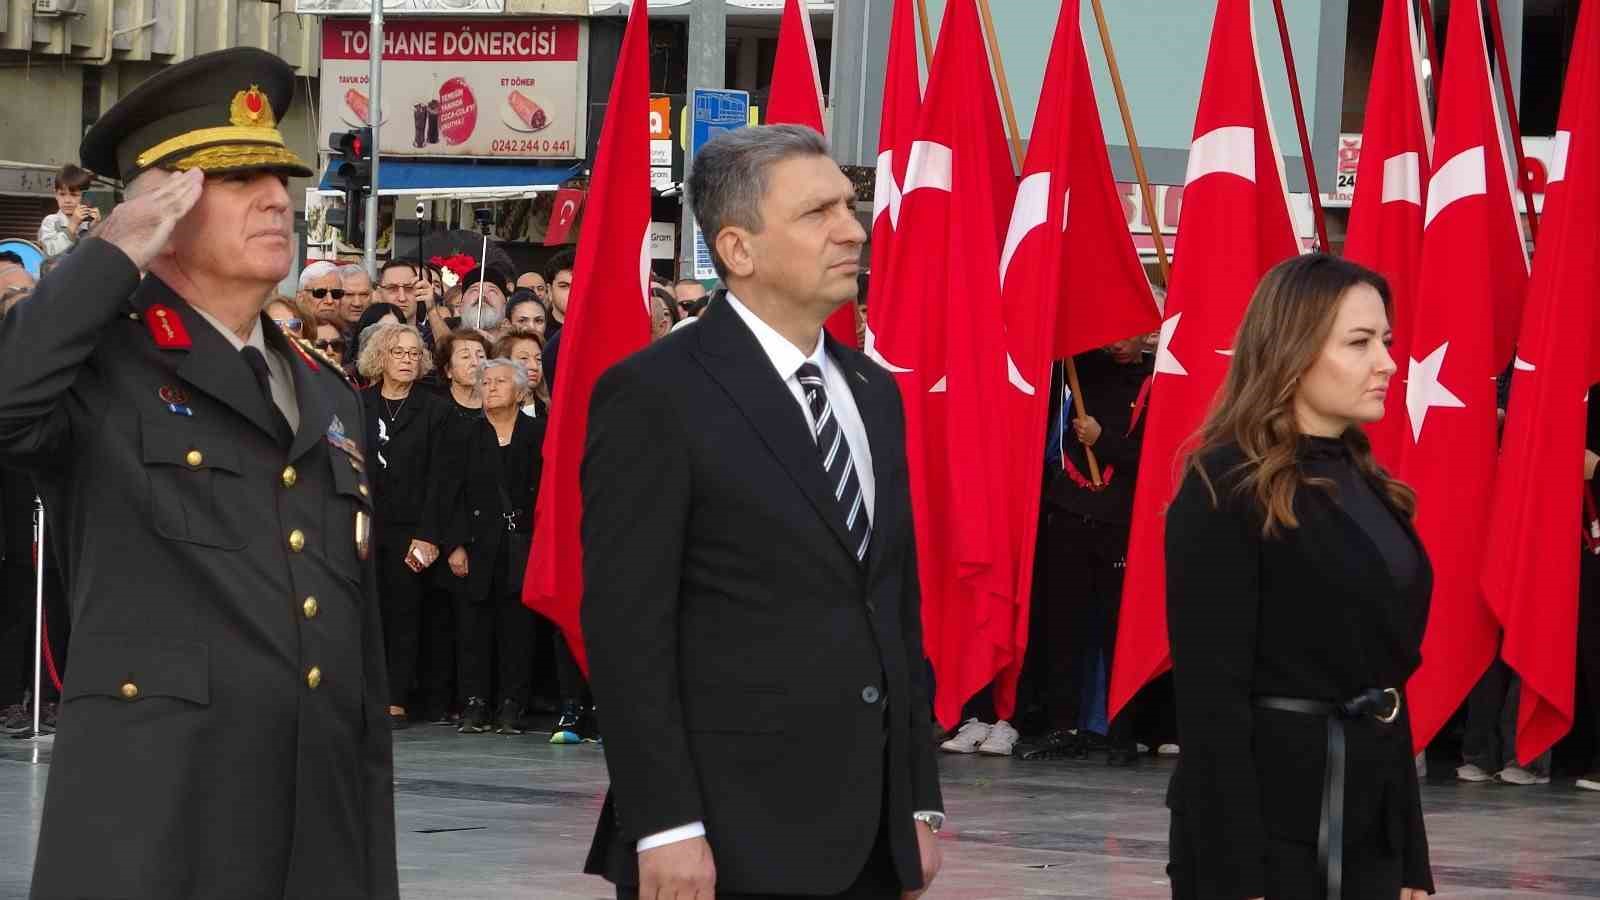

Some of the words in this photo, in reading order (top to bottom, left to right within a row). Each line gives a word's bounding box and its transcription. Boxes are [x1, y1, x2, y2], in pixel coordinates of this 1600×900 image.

[341, 31, 437, 55] TOHANE
[443, 26, 557, 56] DÖNERCİSİ
[500, 78, 509, 86] ET
[511, 76, 535, 86] DÖNER
[492, 140, 518, 152] 0242
[520, 140, 539, 152] 244
[542, 140, 550, 152] 0
[552, 140, 570, 152] 441
[1338, 175, 1355, 188] 24
